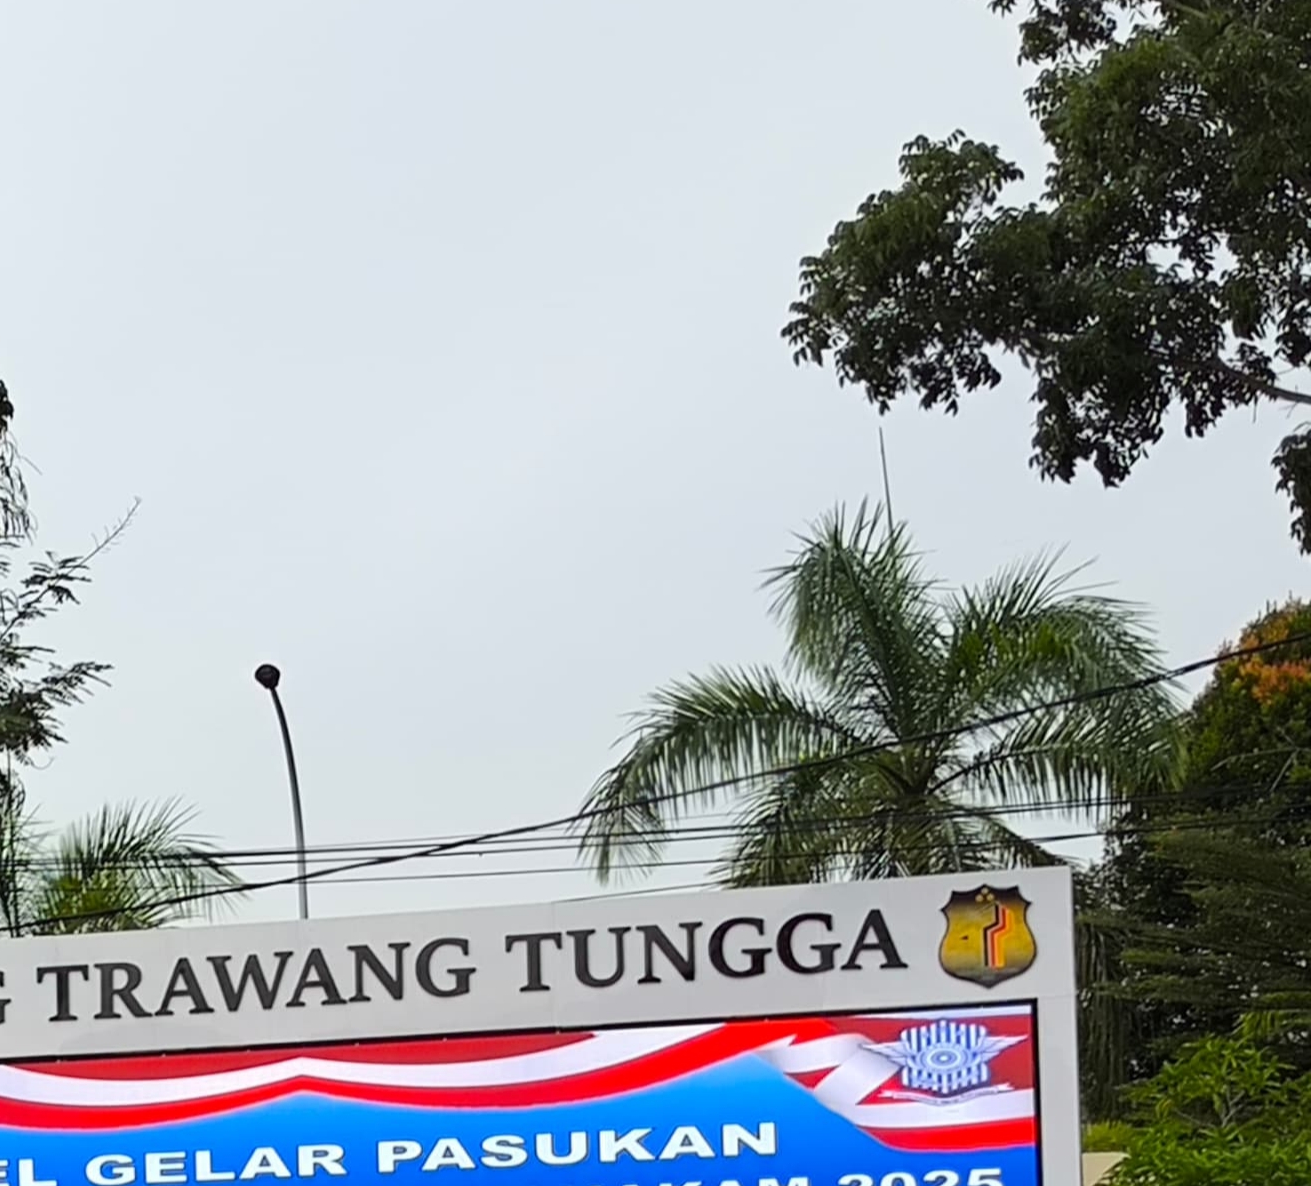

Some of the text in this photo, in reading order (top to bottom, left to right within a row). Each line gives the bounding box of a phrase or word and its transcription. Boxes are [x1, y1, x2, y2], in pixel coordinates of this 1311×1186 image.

[37, 938, 477, 1022] TRAWANG
[505, 909, 908, 993] TUNGGA
[85, 1144, 347, 1186] GELAR
[377, 1122, 777, 1173] PASUKAN
